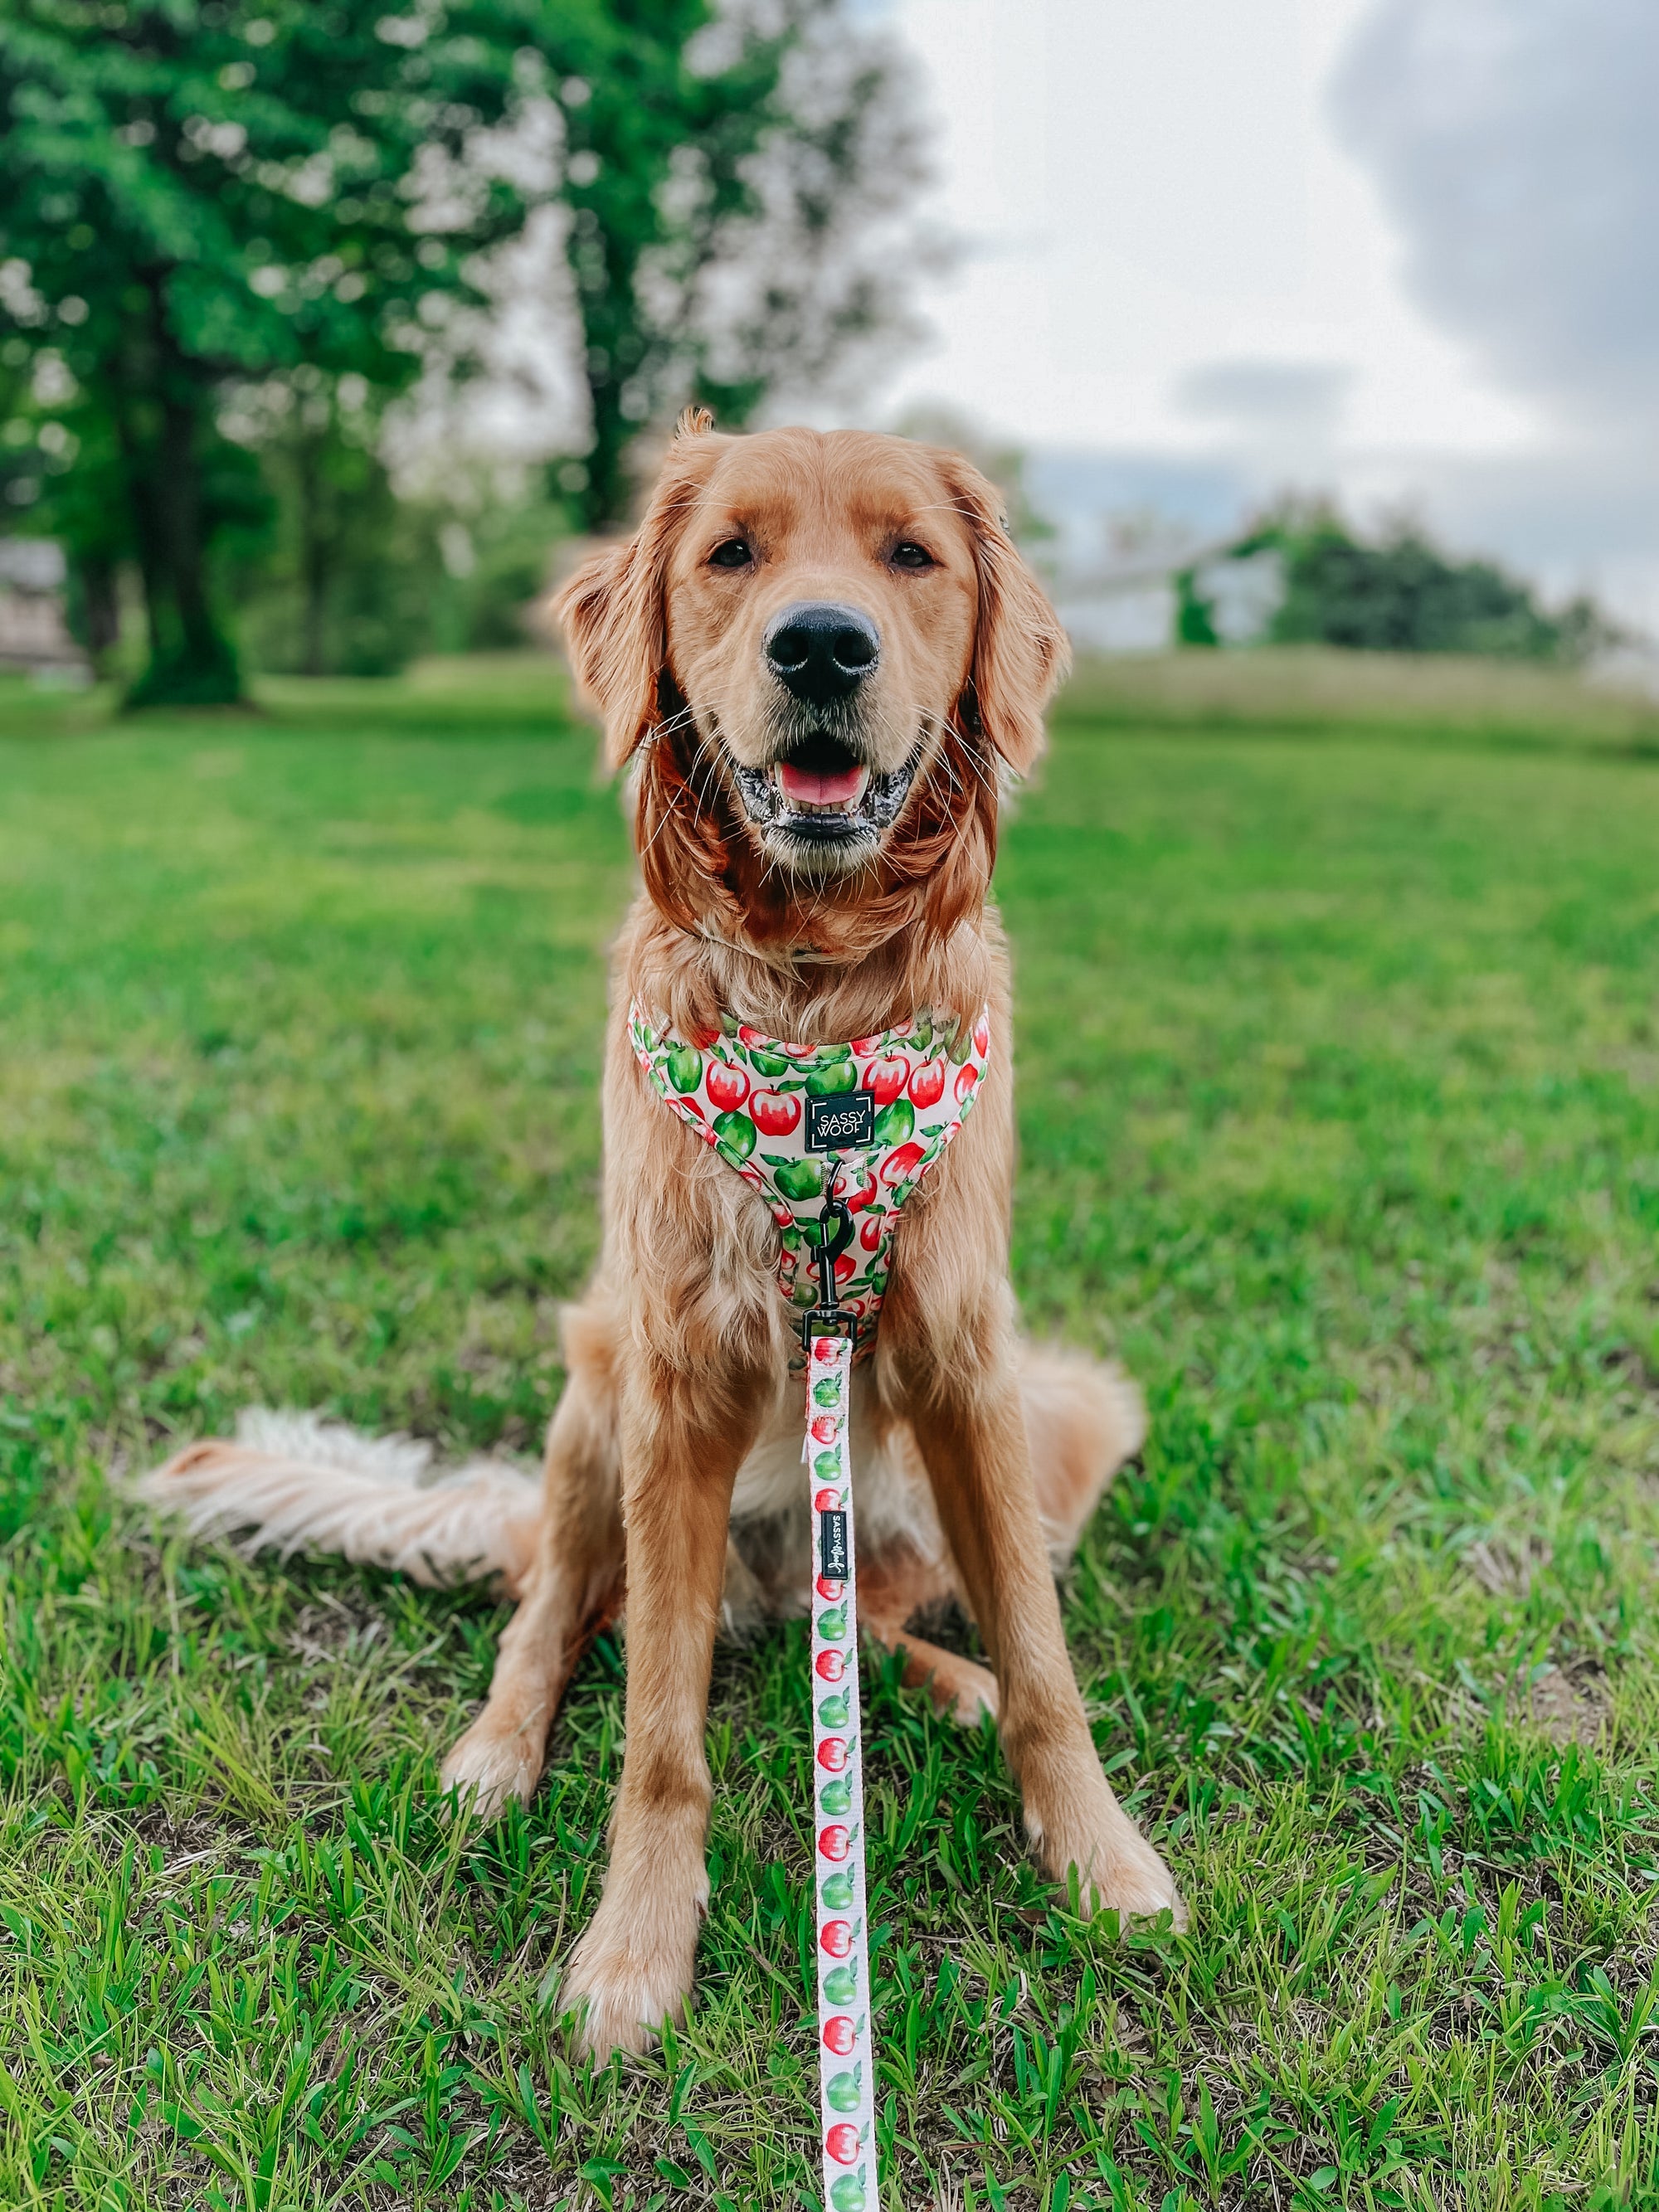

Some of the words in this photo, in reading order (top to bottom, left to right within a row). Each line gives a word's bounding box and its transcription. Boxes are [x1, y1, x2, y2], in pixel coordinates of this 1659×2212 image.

[820, 1110, 866, 1126] SASSY
[817, 1121, 864, 1137] WOOF
[832, 1515, 841, 1544] SASSY
